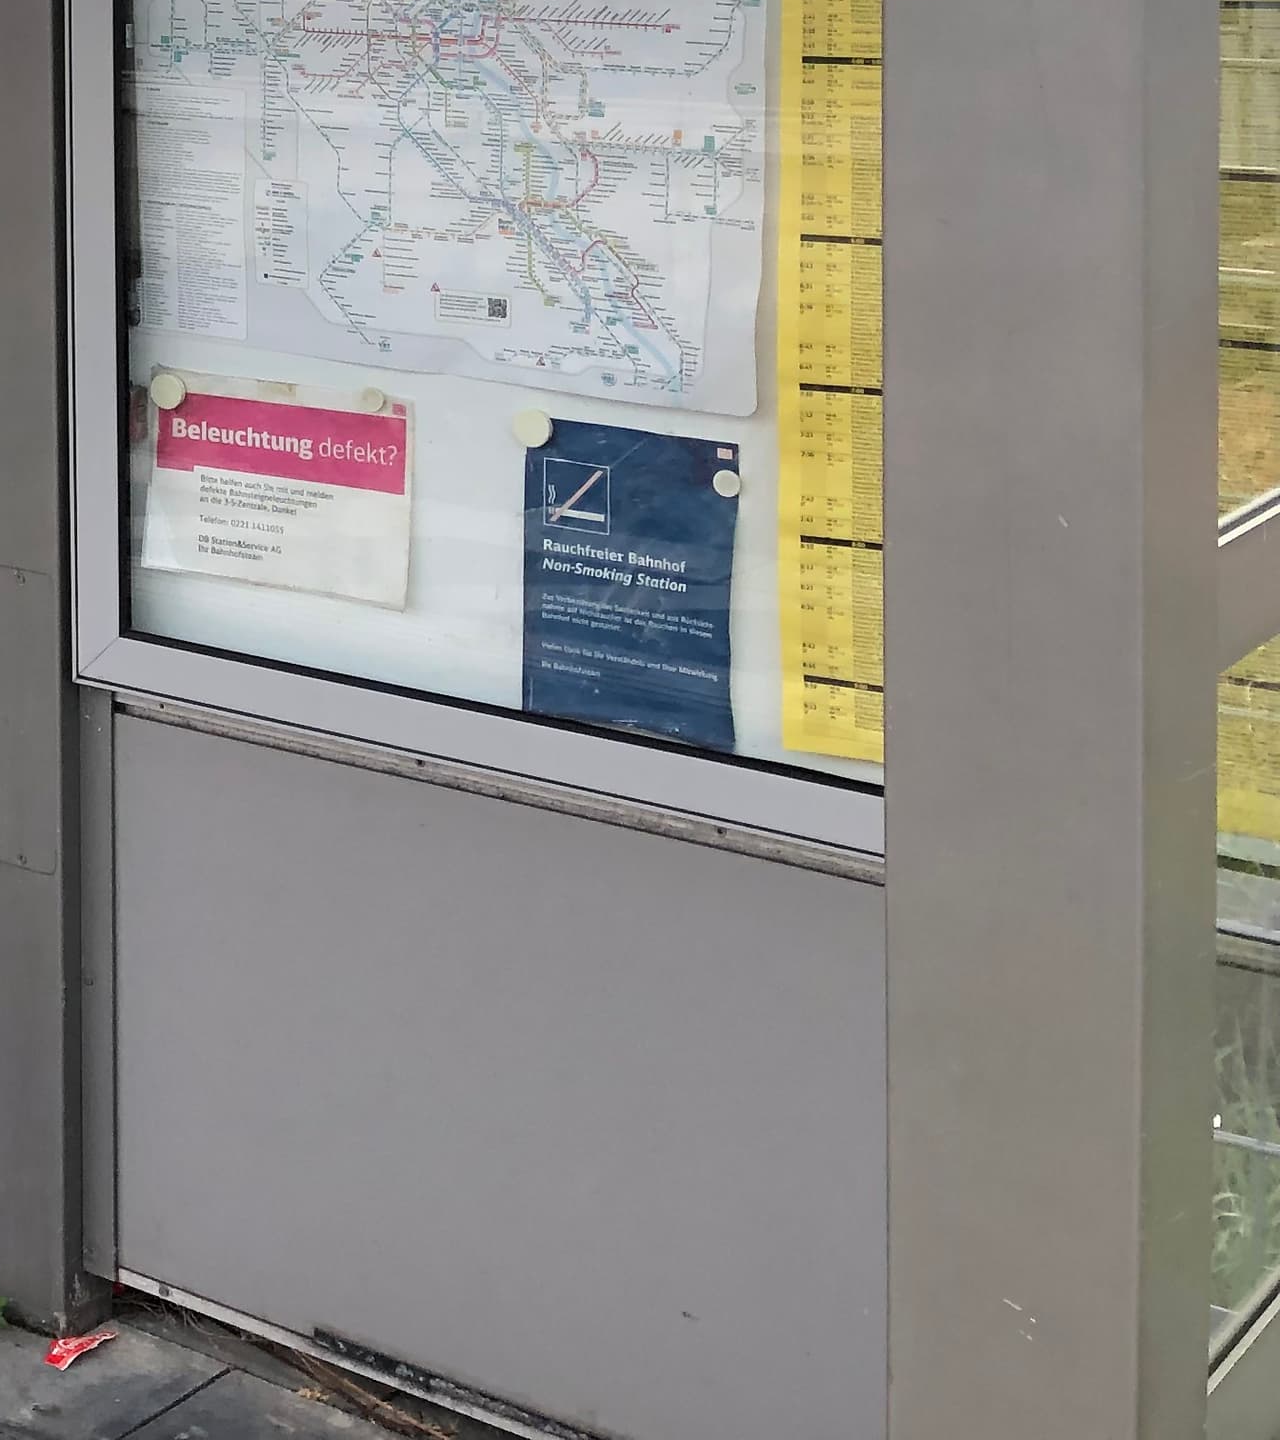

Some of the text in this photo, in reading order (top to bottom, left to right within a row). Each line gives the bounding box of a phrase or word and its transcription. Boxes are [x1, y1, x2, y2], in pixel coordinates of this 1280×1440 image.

[171, 417, 398, 466] Beleuchtung defekt?
[542, 538, 687, 574] Rauchfreier Bahnhof
[542, 558, 688, 593] Non-Smoking Station
